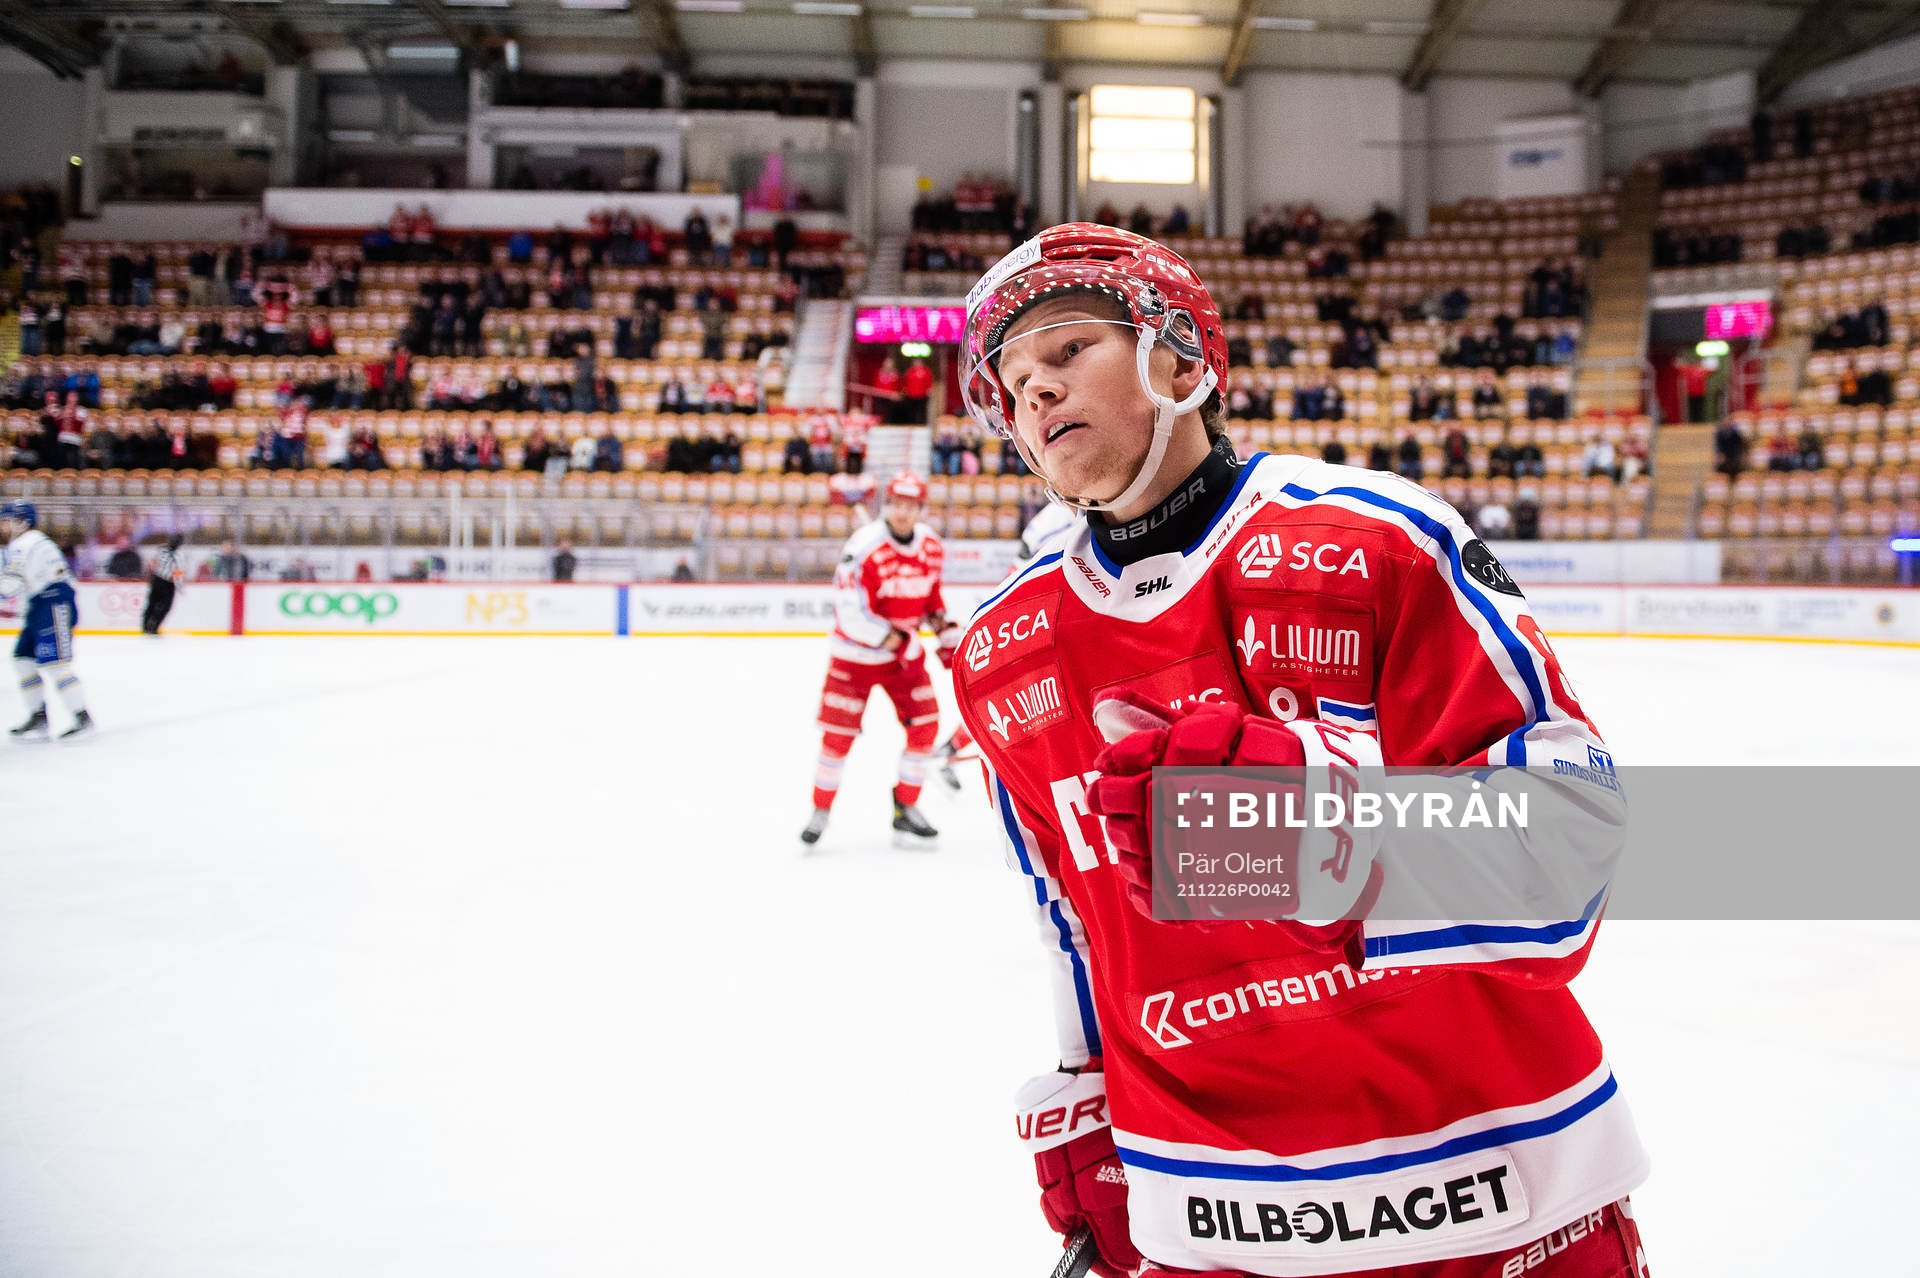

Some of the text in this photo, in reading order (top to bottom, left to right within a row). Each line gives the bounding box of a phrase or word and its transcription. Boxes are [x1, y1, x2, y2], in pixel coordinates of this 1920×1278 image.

[1110, 477, 1206, 541] BAUER
[1071, 556, 1112, 598] BAUER
[1288, 541, 1369, 579] SCA
[279, 591, 398, 624] coop
[1134, 576, 1173, 598] SHL
[997, 608, 1050, 649] SCA
[1270, 624, 1360, 666] LILIUM
[1272, 663, 1359, 676] FASTIGHETER
[1553, 759, 1617, 792] SUNDSVALLS
[1313, 722, 1361, 884] UER
[1016, 1094, 1106, 1140] UER
[1187, 1165, 1509, 1244] BILBOLAGET
[1501, 1207, 1605, 1278] BAUER
